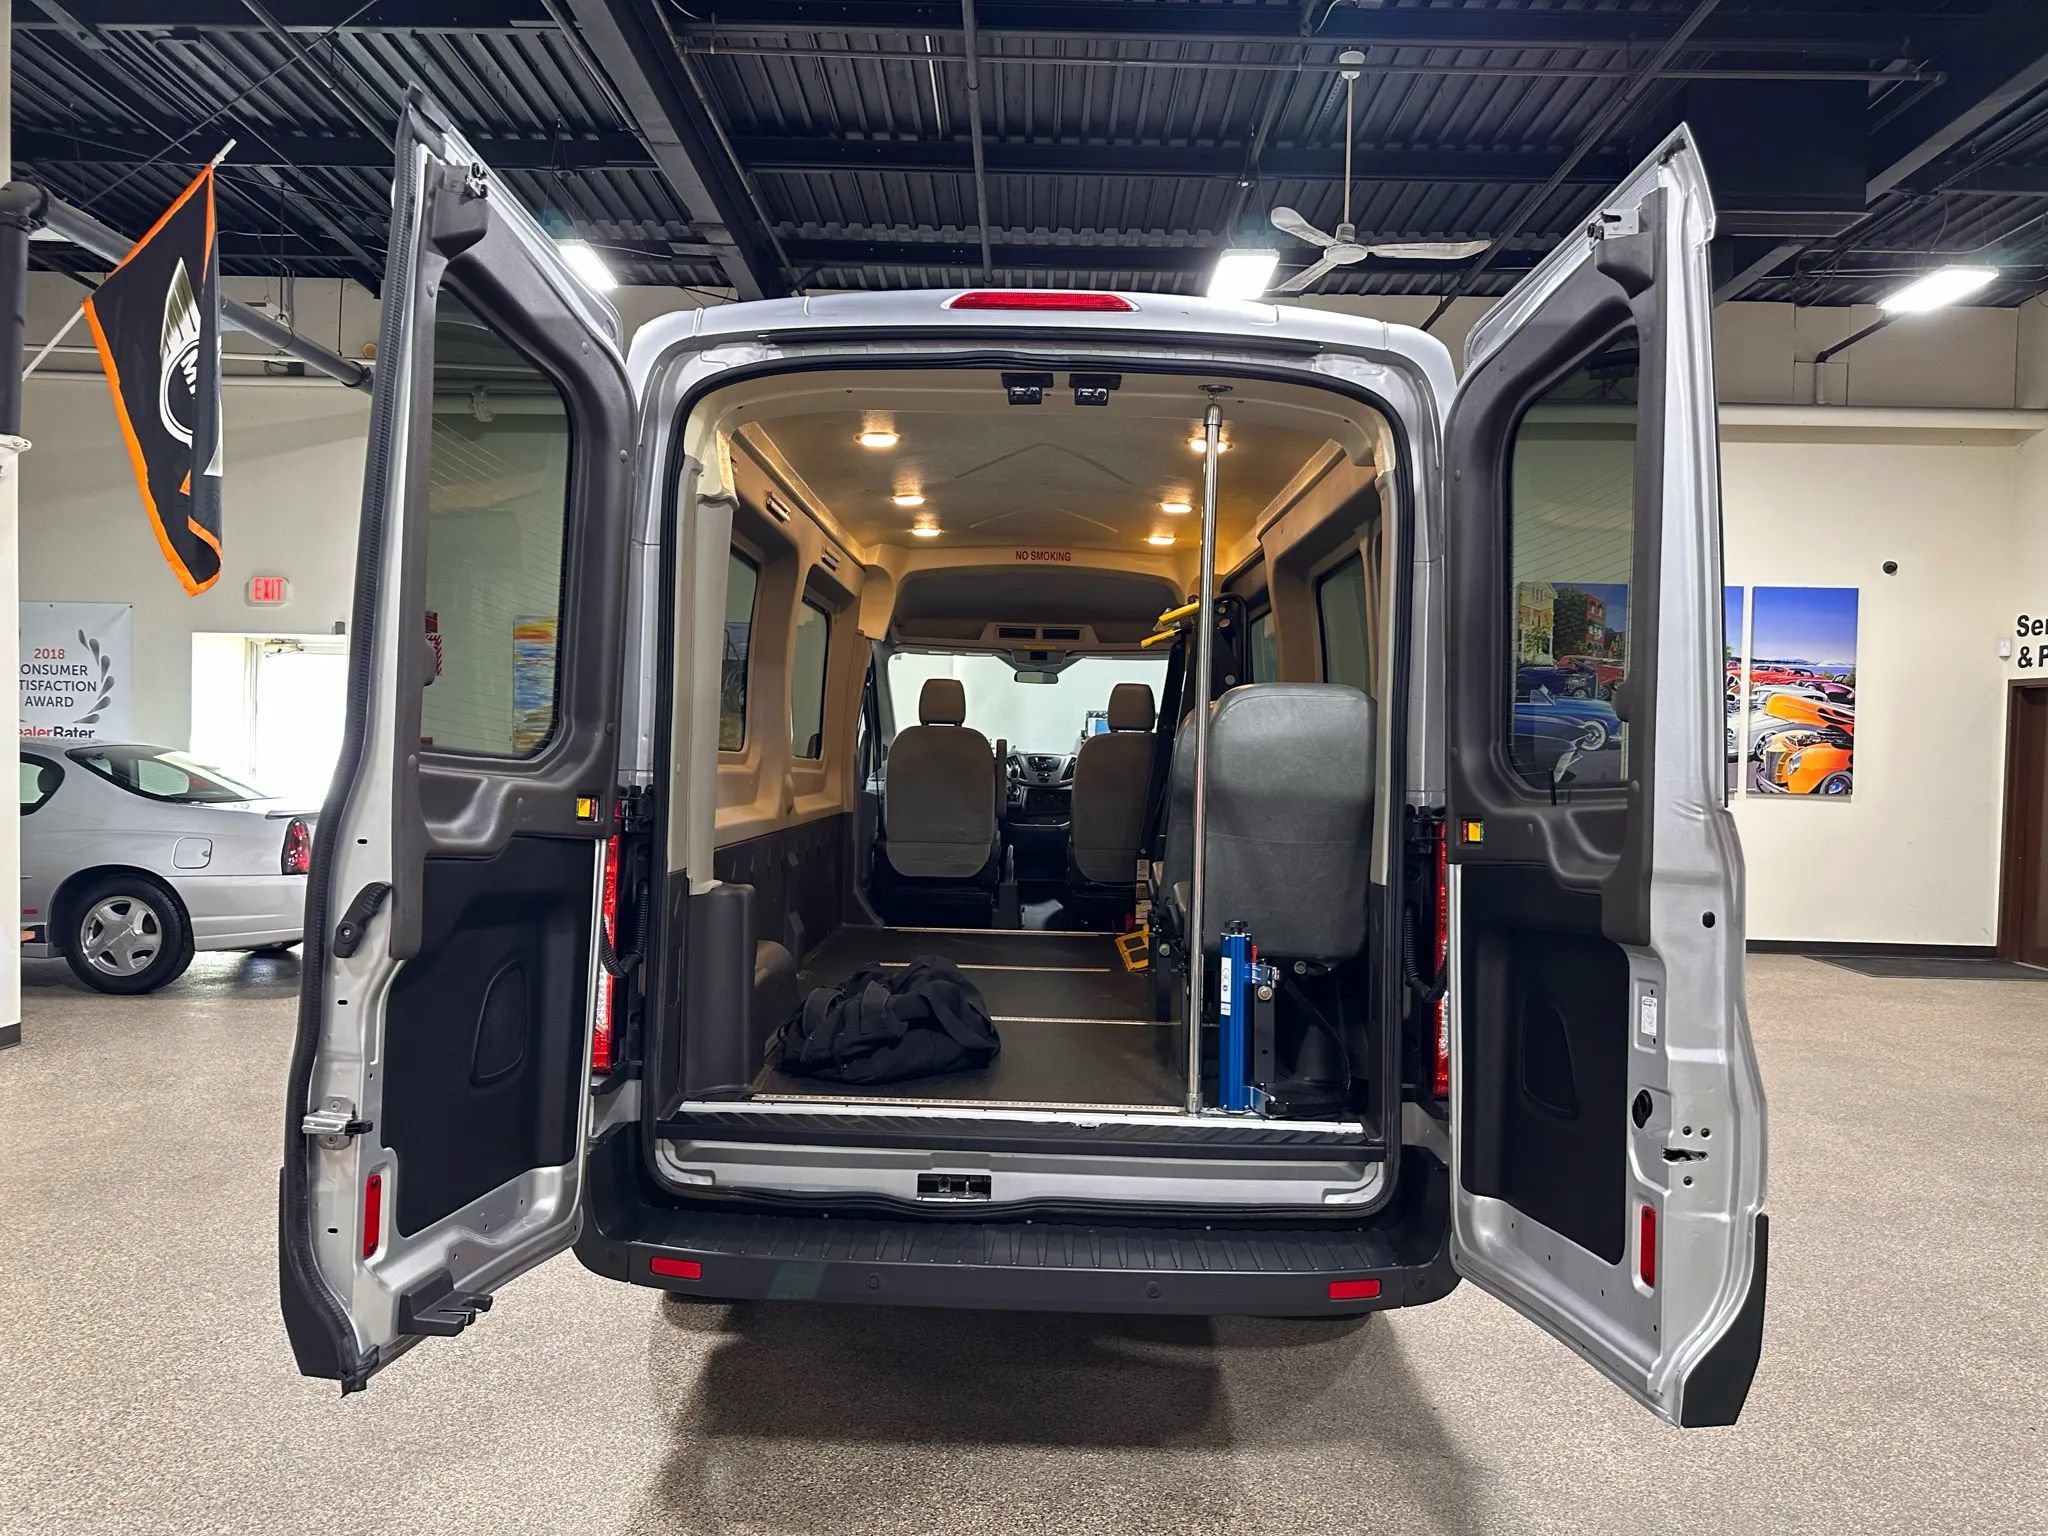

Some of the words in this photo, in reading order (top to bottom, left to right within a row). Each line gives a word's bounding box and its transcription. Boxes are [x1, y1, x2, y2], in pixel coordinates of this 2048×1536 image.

[1015, 550, 1029, 561] NO
[1030, 551, 1072, 562] SMOKING
[255, 578, 283, 601] EXIT
[33, 648, 66, 660] 2018
[2017, 645, 2034, 669] &
[24, 696, 75, 708] AWARD
